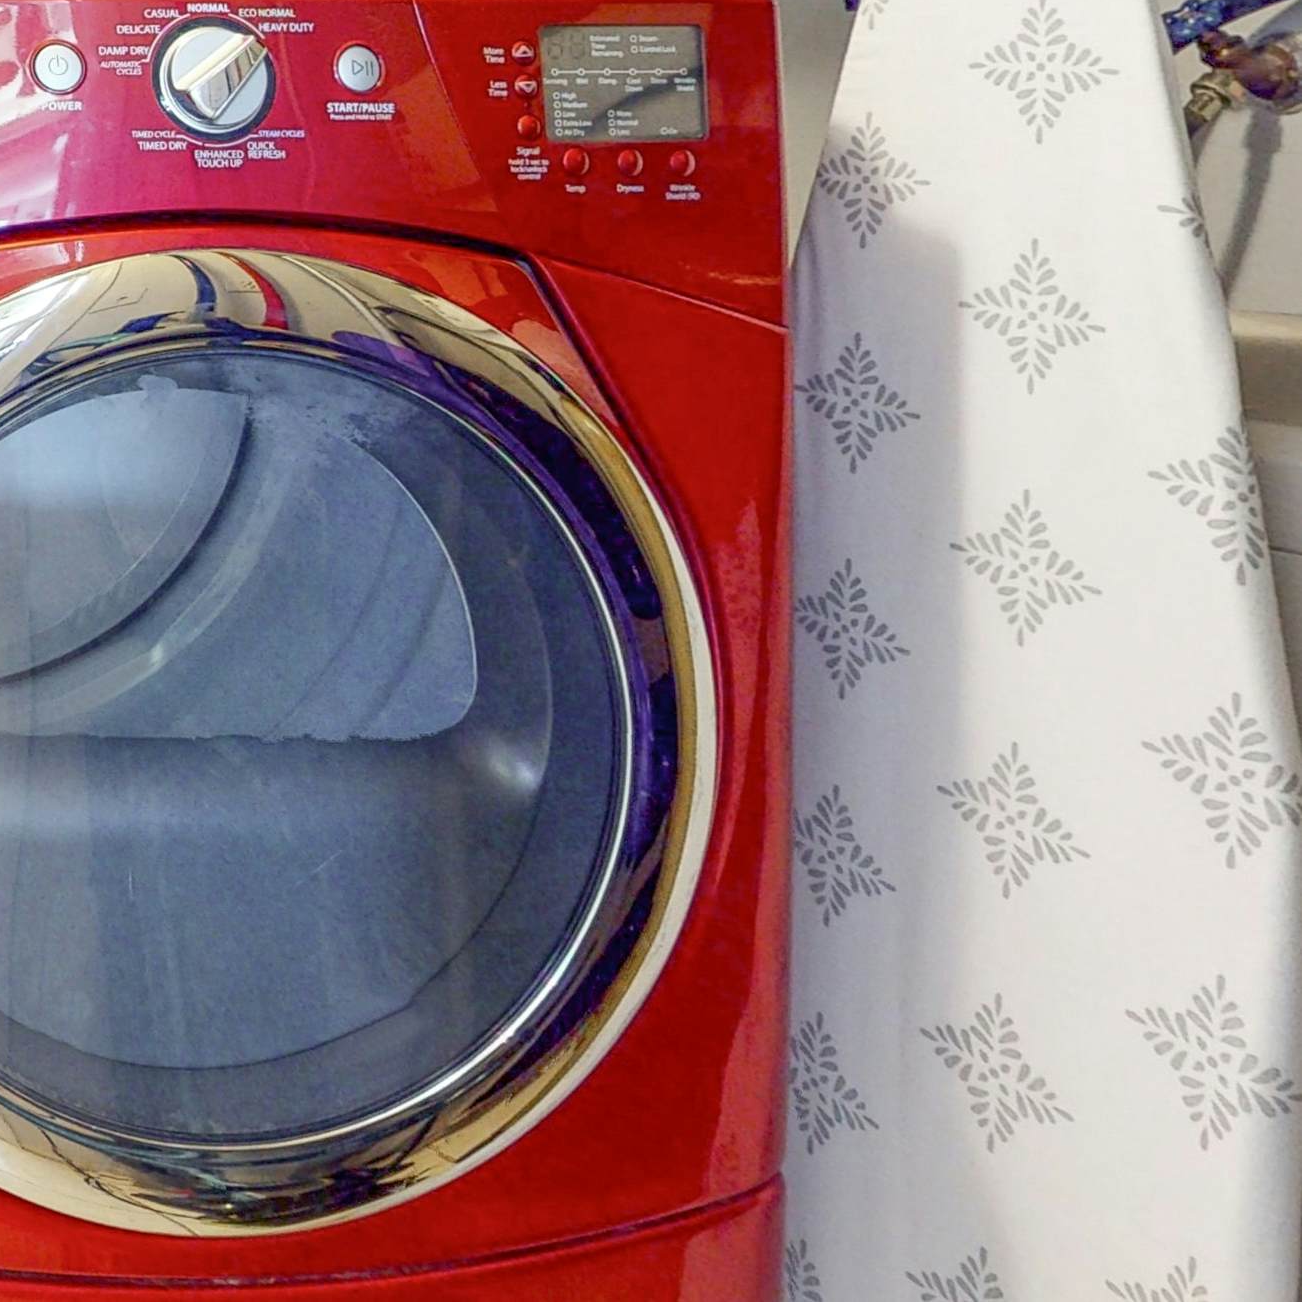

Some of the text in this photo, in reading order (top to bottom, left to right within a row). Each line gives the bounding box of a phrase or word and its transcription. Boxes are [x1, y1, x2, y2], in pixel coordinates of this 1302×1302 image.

[187, 3, 230, 12] NORMAL
[144, 8, 179, 18] CASUAL
[238, 8, 296, 17] ECO NORMAL
[116, 25, 161, 34] DELICATE
[258, 22, 314, 32] HEAVY DUTY
[98, 46, 149, 55] DAMP DRY
[326, 101, 395, 113] START/PAUSE
[138, 141, 188, 150] TIMED DRY
[247, 141, 275, 149] QUICK
[195, 150, 245, 159] ENHANCED
[248, 150, 286, 159] REFRESH
[197, 159, 243, 168] TOUCH UP
